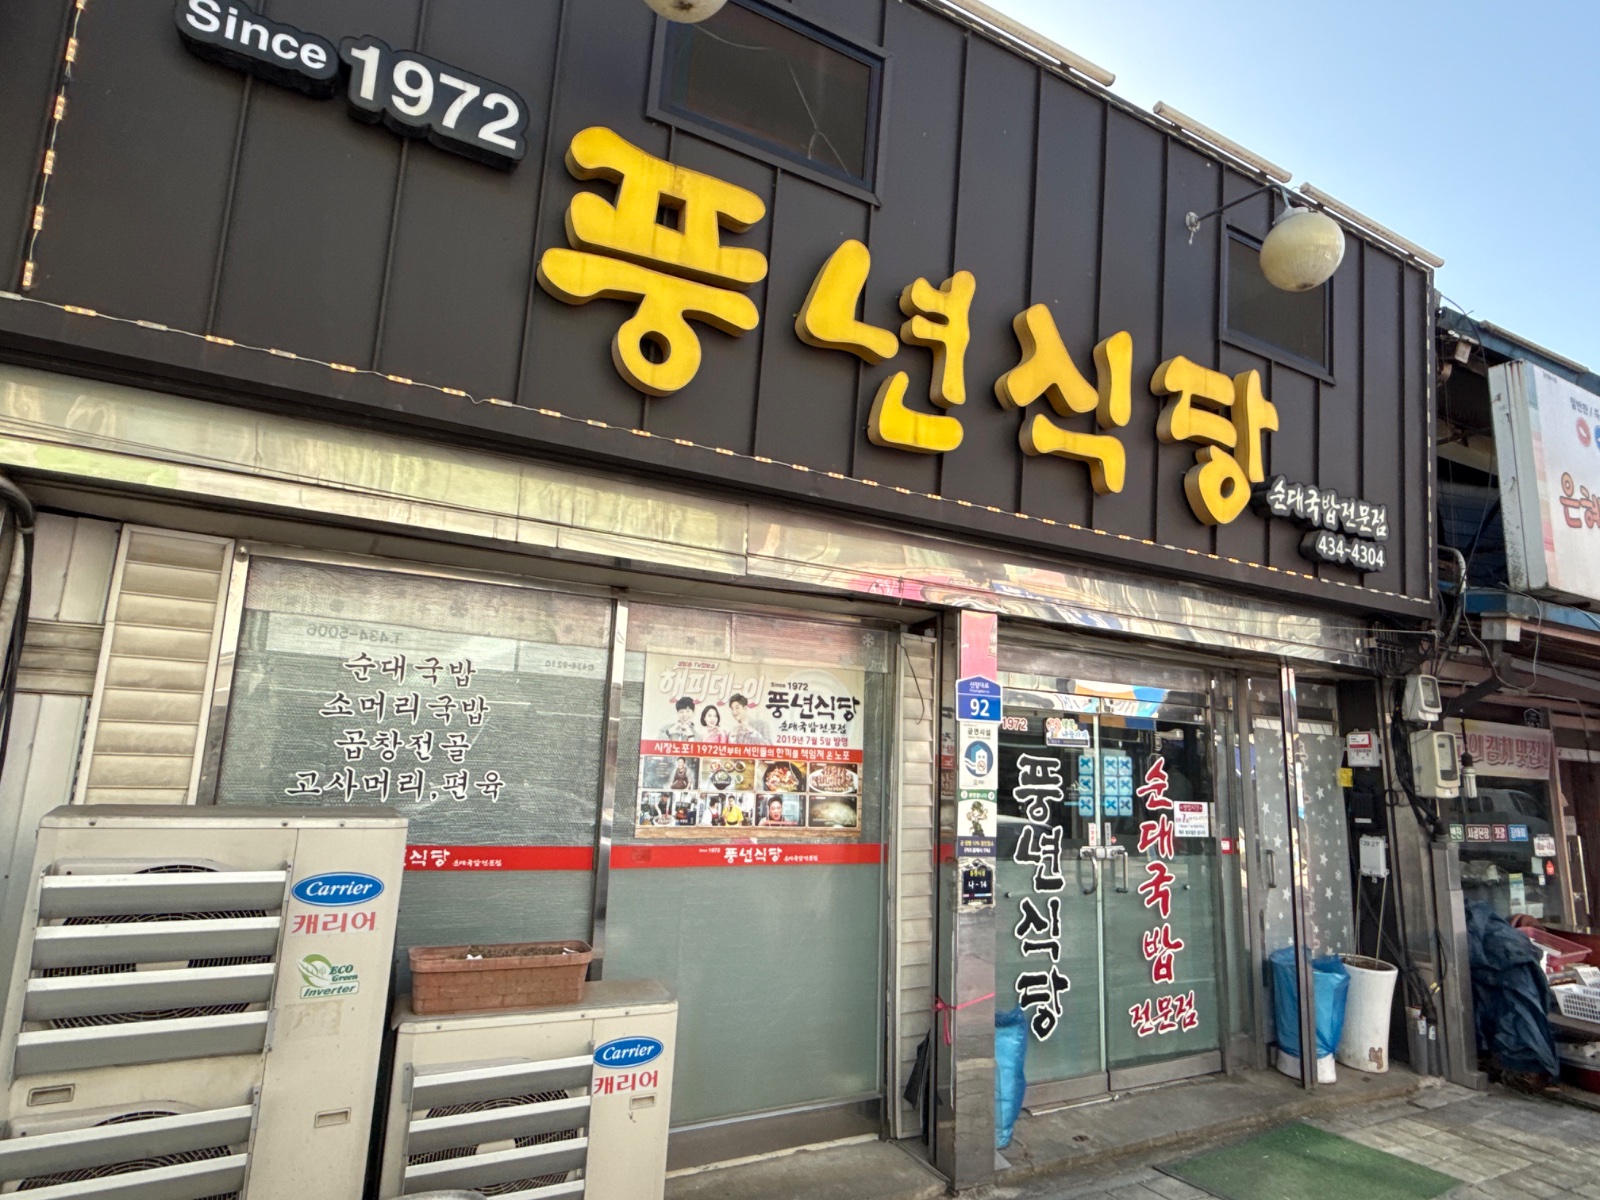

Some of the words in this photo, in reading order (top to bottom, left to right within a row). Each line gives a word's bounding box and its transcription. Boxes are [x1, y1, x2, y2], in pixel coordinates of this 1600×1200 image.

[186, 0, 327, 69] Since
[351, 46, 517, 150] 1972
[537, 126, 1280, 525] 풍년식당
[1269, 480, 1387, 537] 순대국밥전문점
[1318, 535, 1385, 568] 434-4304
[344, 652, 477, 688] 순대국밥
[787, 682, 808, 691] 1972
[319, 690, 491, 725] 소머리국밥
[765, 690, 861, 722] 풍년식당
[970, 698, 990, 717] 92
[1001, 717, 1028, 731] 1972
[334, 728, 473, 762] 곱창전골
[696, 744, 742, 756] 1972년부터
[776, 734, 804, 745] 2019년
[805, 736, 818, 746] 7월
[819, 737, 832, 746] 5일
[403, 848, 451, 867] 식당
[723, 847, 783, 864] 풍년식당
[1137, 757, 1184, 983] 순대국밥
[305, 880, 374, 898] Carrier
[1013, 753, 1070, 1041] 풍년식당
[291, 911, 377, 935] 캐리어
[330, 964, 354, 976] ECO
[332, 973, 359, 983] Green
[303, 985, 358, 998] Inverter
[1129, 991, 1198, 1037] 전문점
[602, 1044, 655, 1062] Carrier
[593, 1070, 659, 1095] 캐리어
